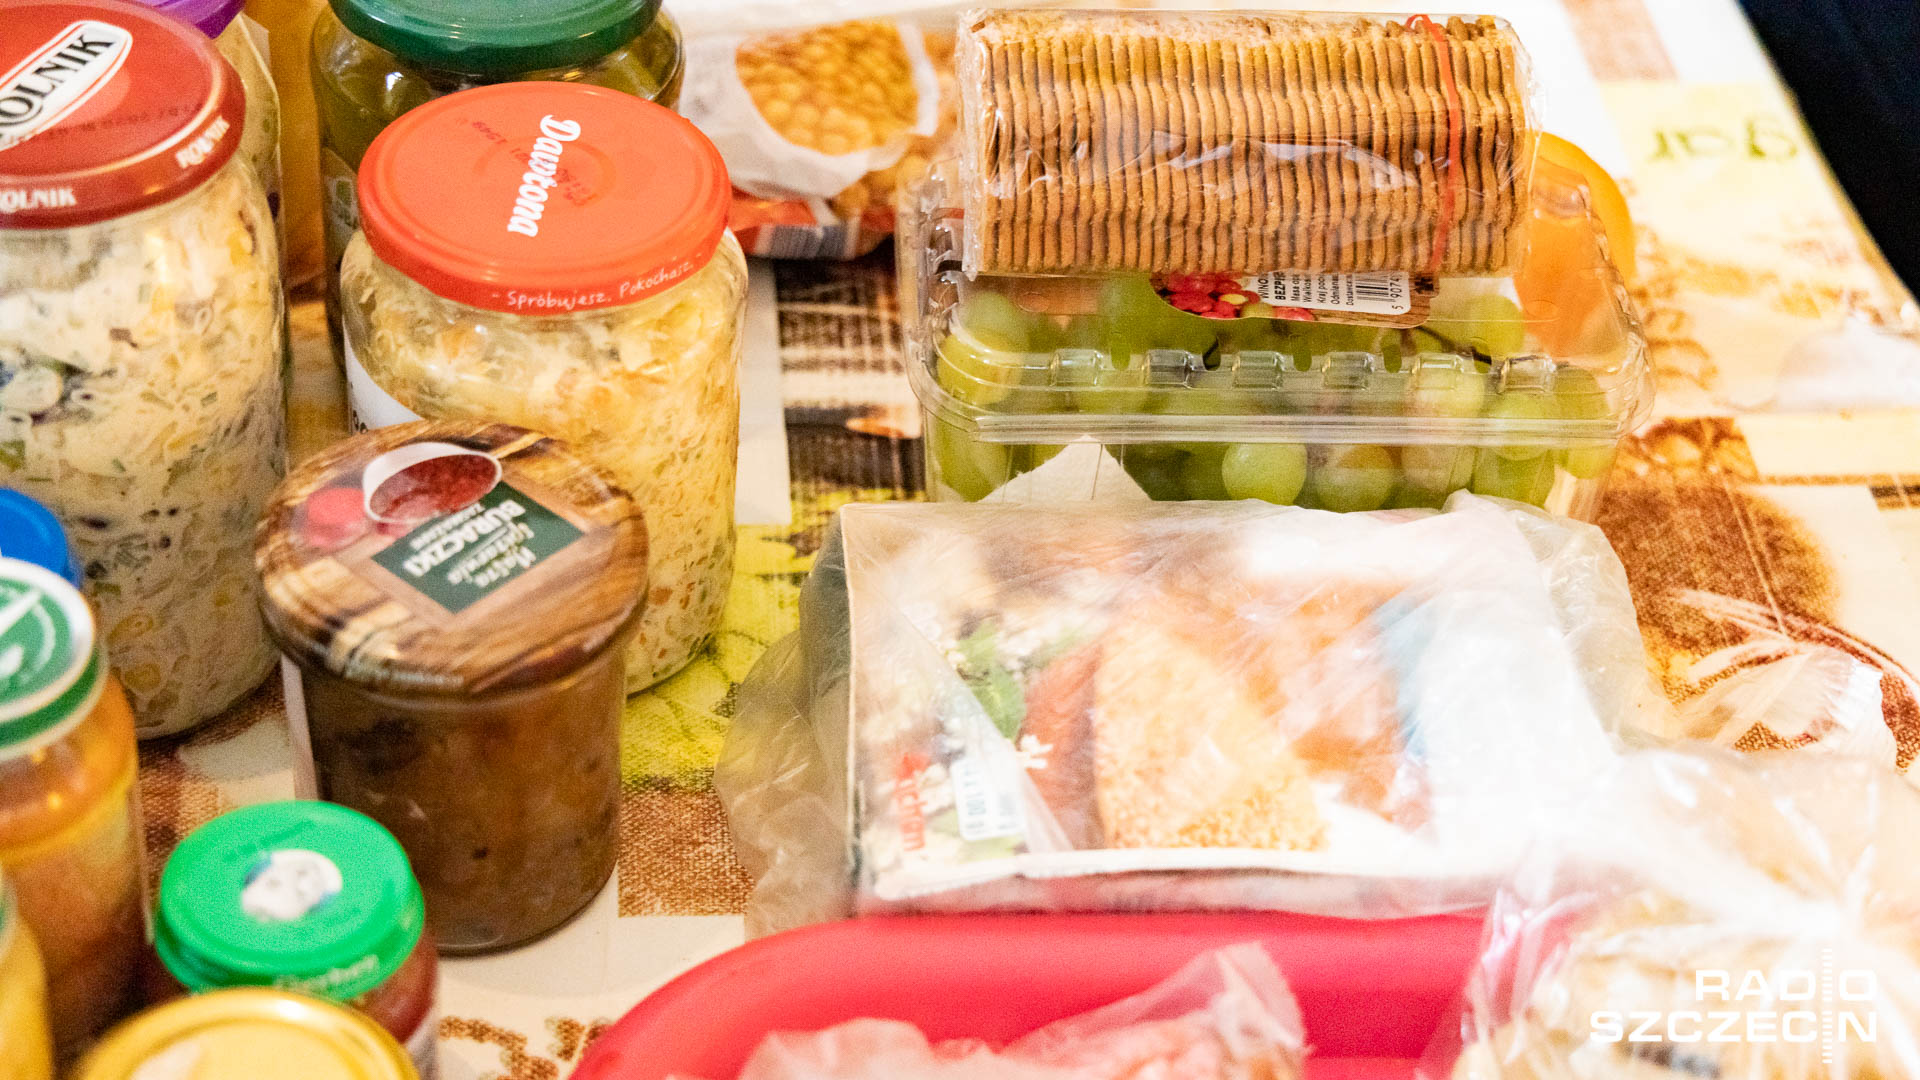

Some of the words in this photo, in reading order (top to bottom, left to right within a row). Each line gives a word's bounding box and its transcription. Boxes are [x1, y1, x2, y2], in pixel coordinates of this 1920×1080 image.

[0, 34, 115, 127] OLNIK
[0, 187, 77, 214] OLNIK
[507, 114, 581, 238] Dawtona
